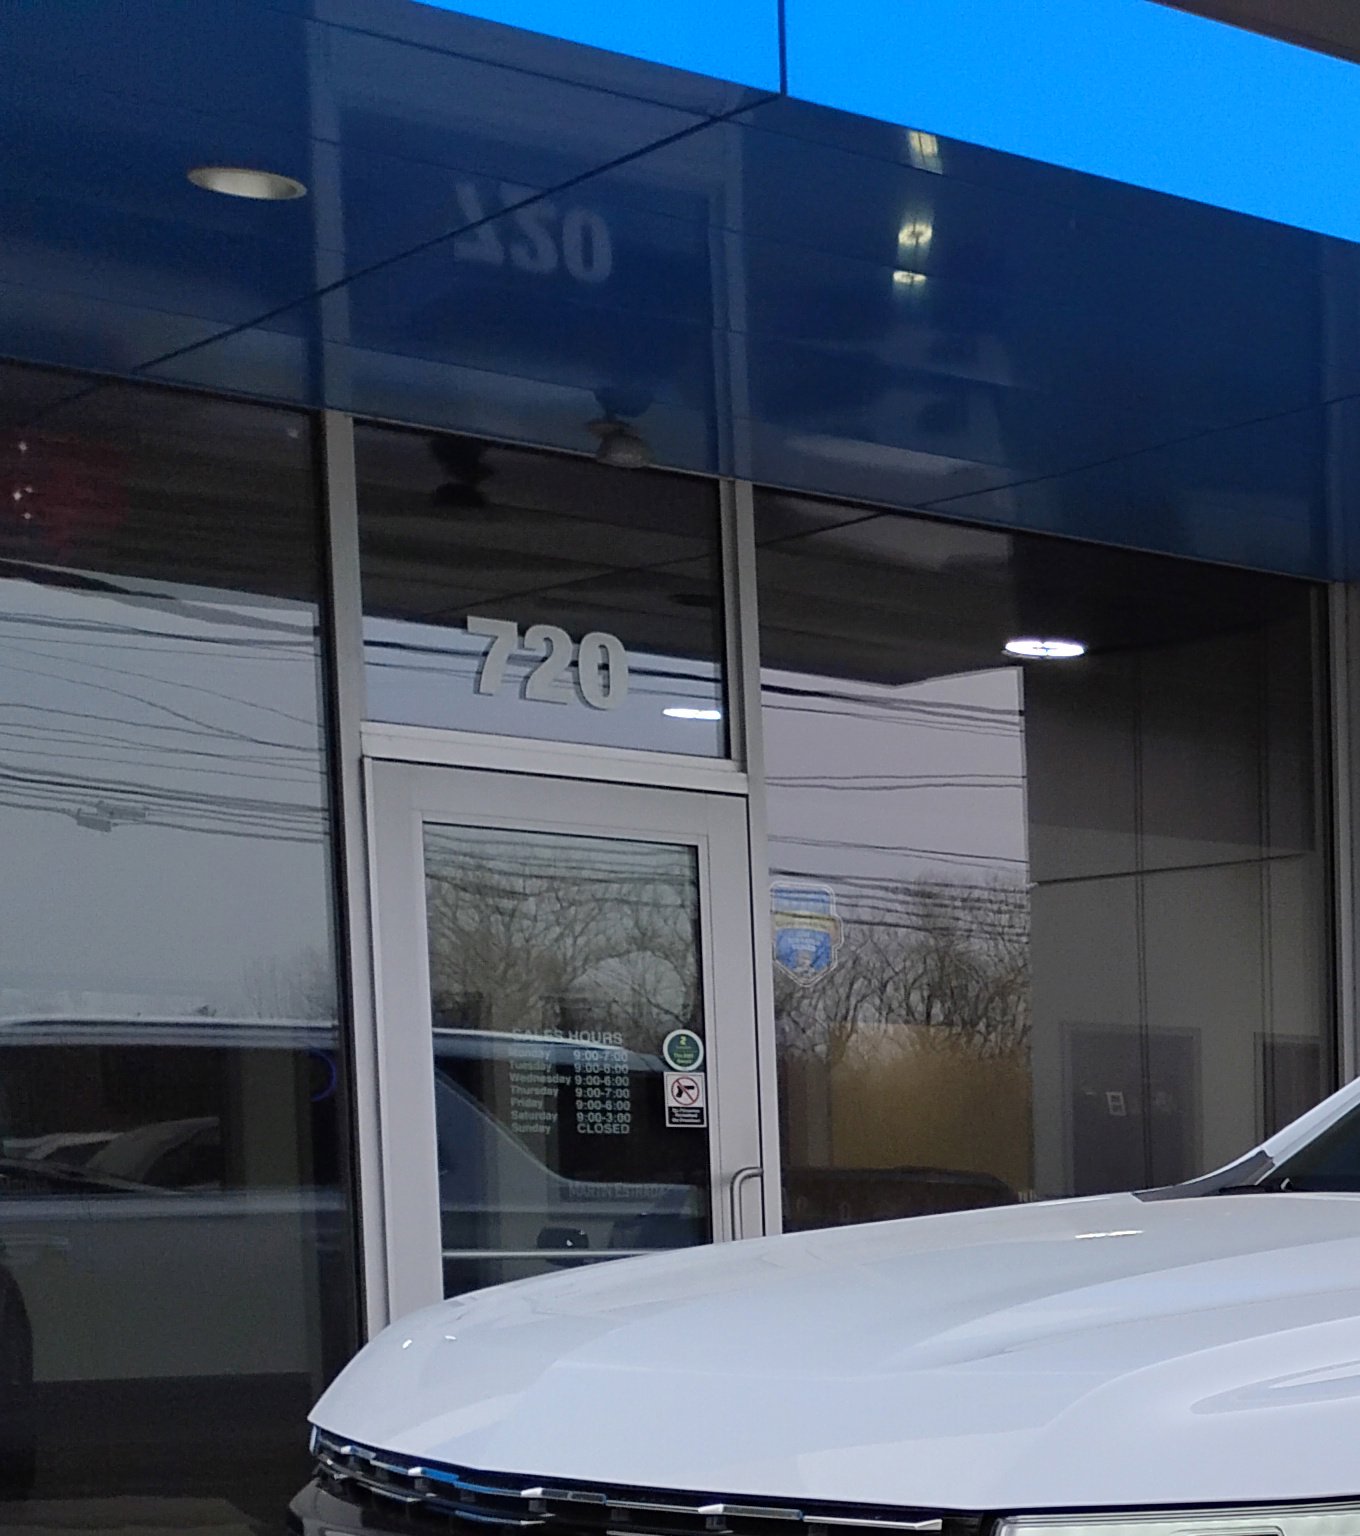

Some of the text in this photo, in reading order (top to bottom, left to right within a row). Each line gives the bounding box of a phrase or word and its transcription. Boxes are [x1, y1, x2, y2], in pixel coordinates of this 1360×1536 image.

[466, 615, 629, 711] 720
[511, 1028, 624, 1045] SALES HOURS
[508, 1046, 629, 1062] Monday 9:00-7:00
[509, 1060, 551, 1073] Tuesday
[509, 1073, 630, 1086] Wednesday 9:00-6:00
[510, 1085, 631, 1099] Thursday 9:00-7:00
[510, 1097, 631, 1111] Friday 9:00-6:00
[510, 1109, 632, 1123] Saturday 9:00-3:00
[510, 1122, 631, 1135] Sunday CLOSED
